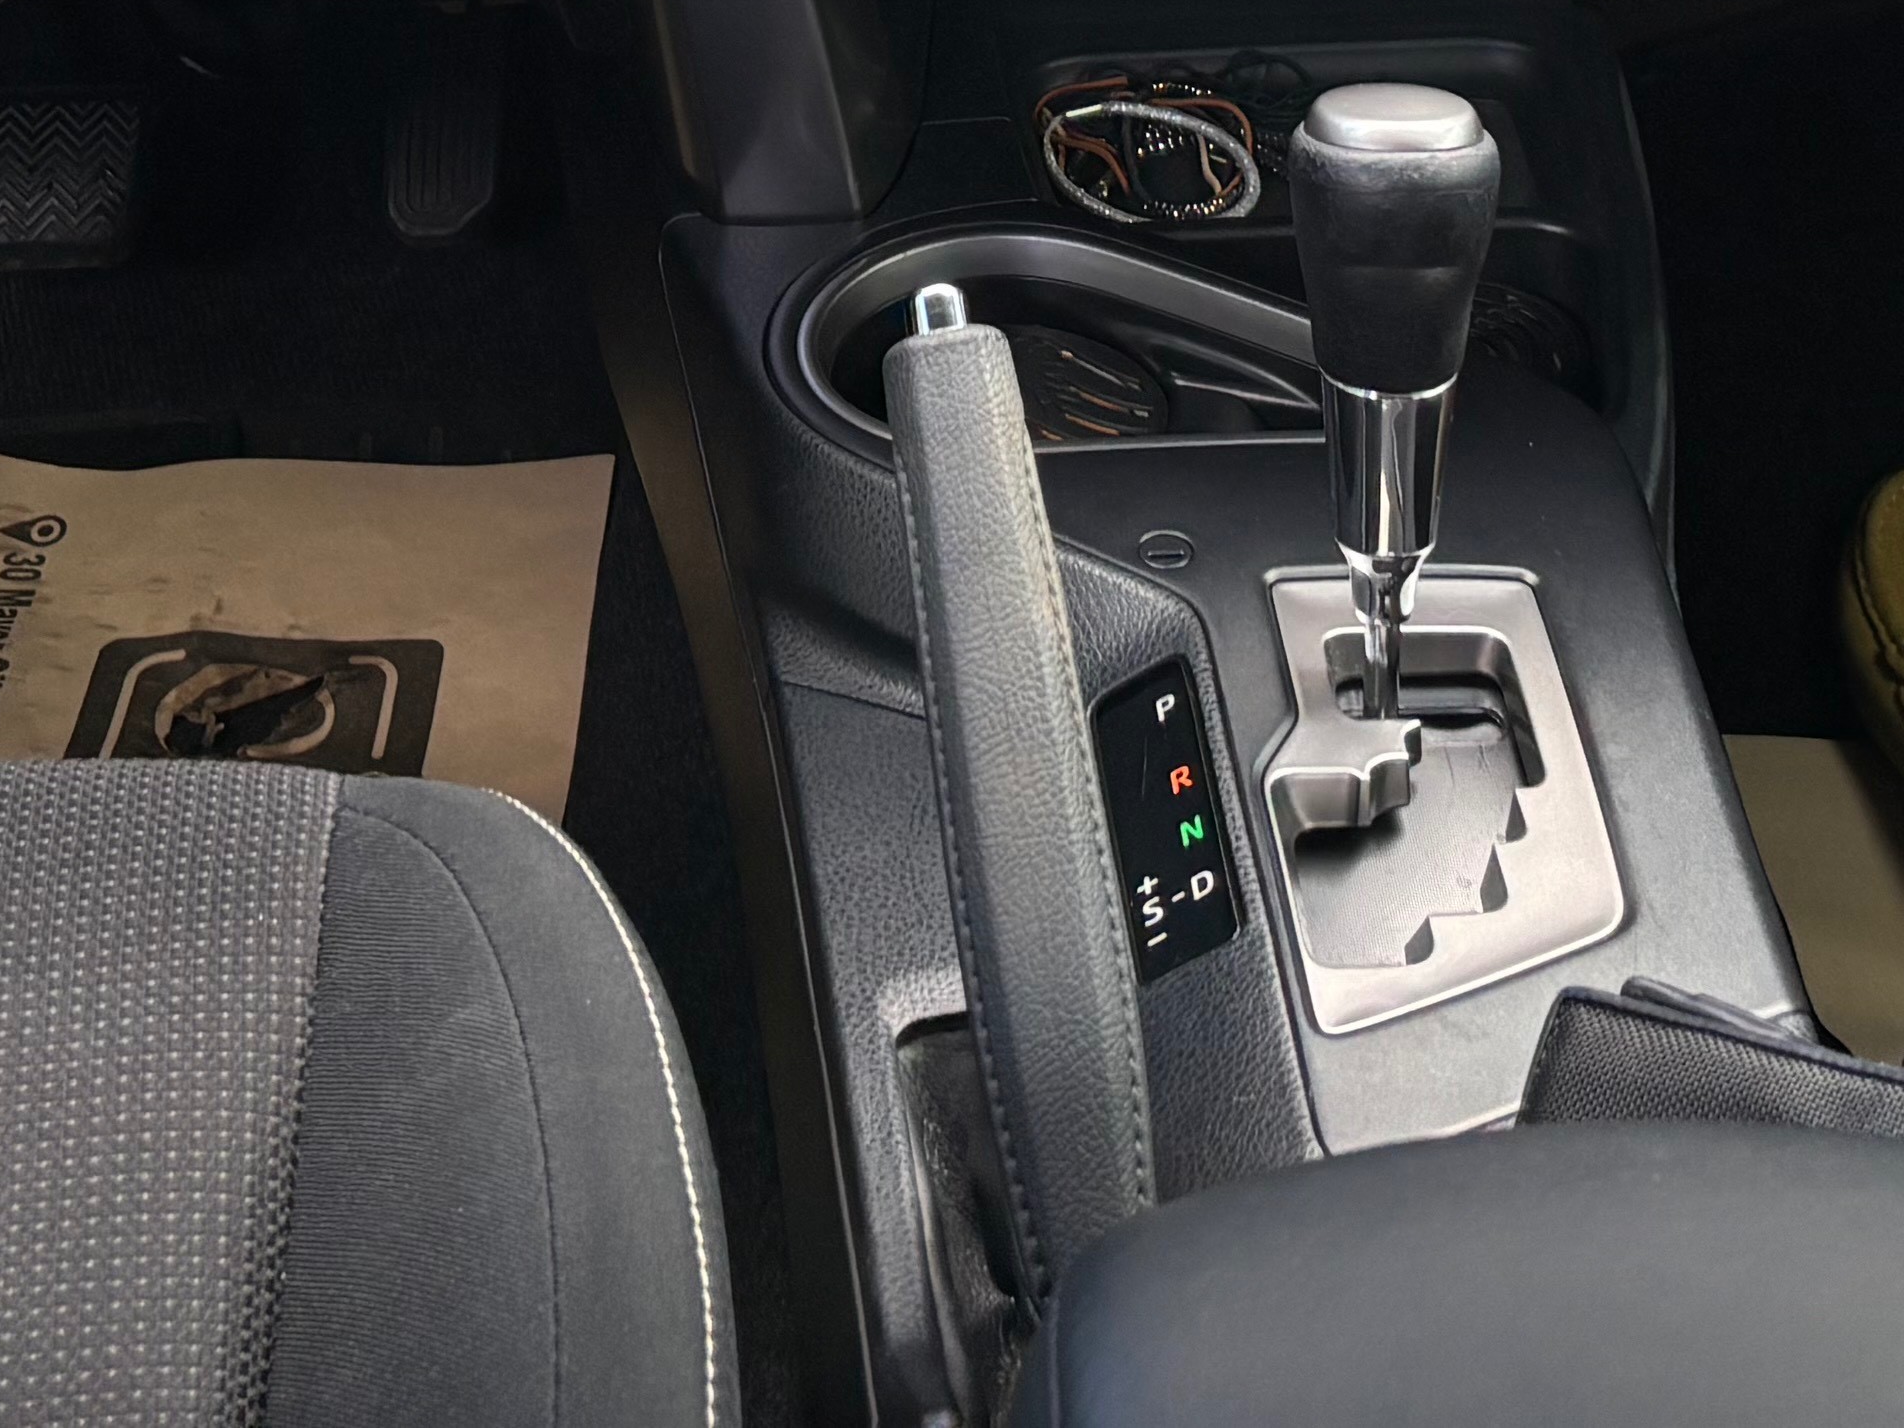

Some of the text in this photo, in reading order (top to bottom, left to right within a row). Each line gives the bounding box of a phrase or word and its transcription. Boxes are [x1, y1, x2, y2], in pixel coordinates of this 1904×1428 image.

[1155, 694, 1175, 723] P
[1170, 766, 1194, 795] R
[1180, 815, 1205, 848] N
[1143, 898, 1163, 927] S
[1190, 870, 1214, 901] D
